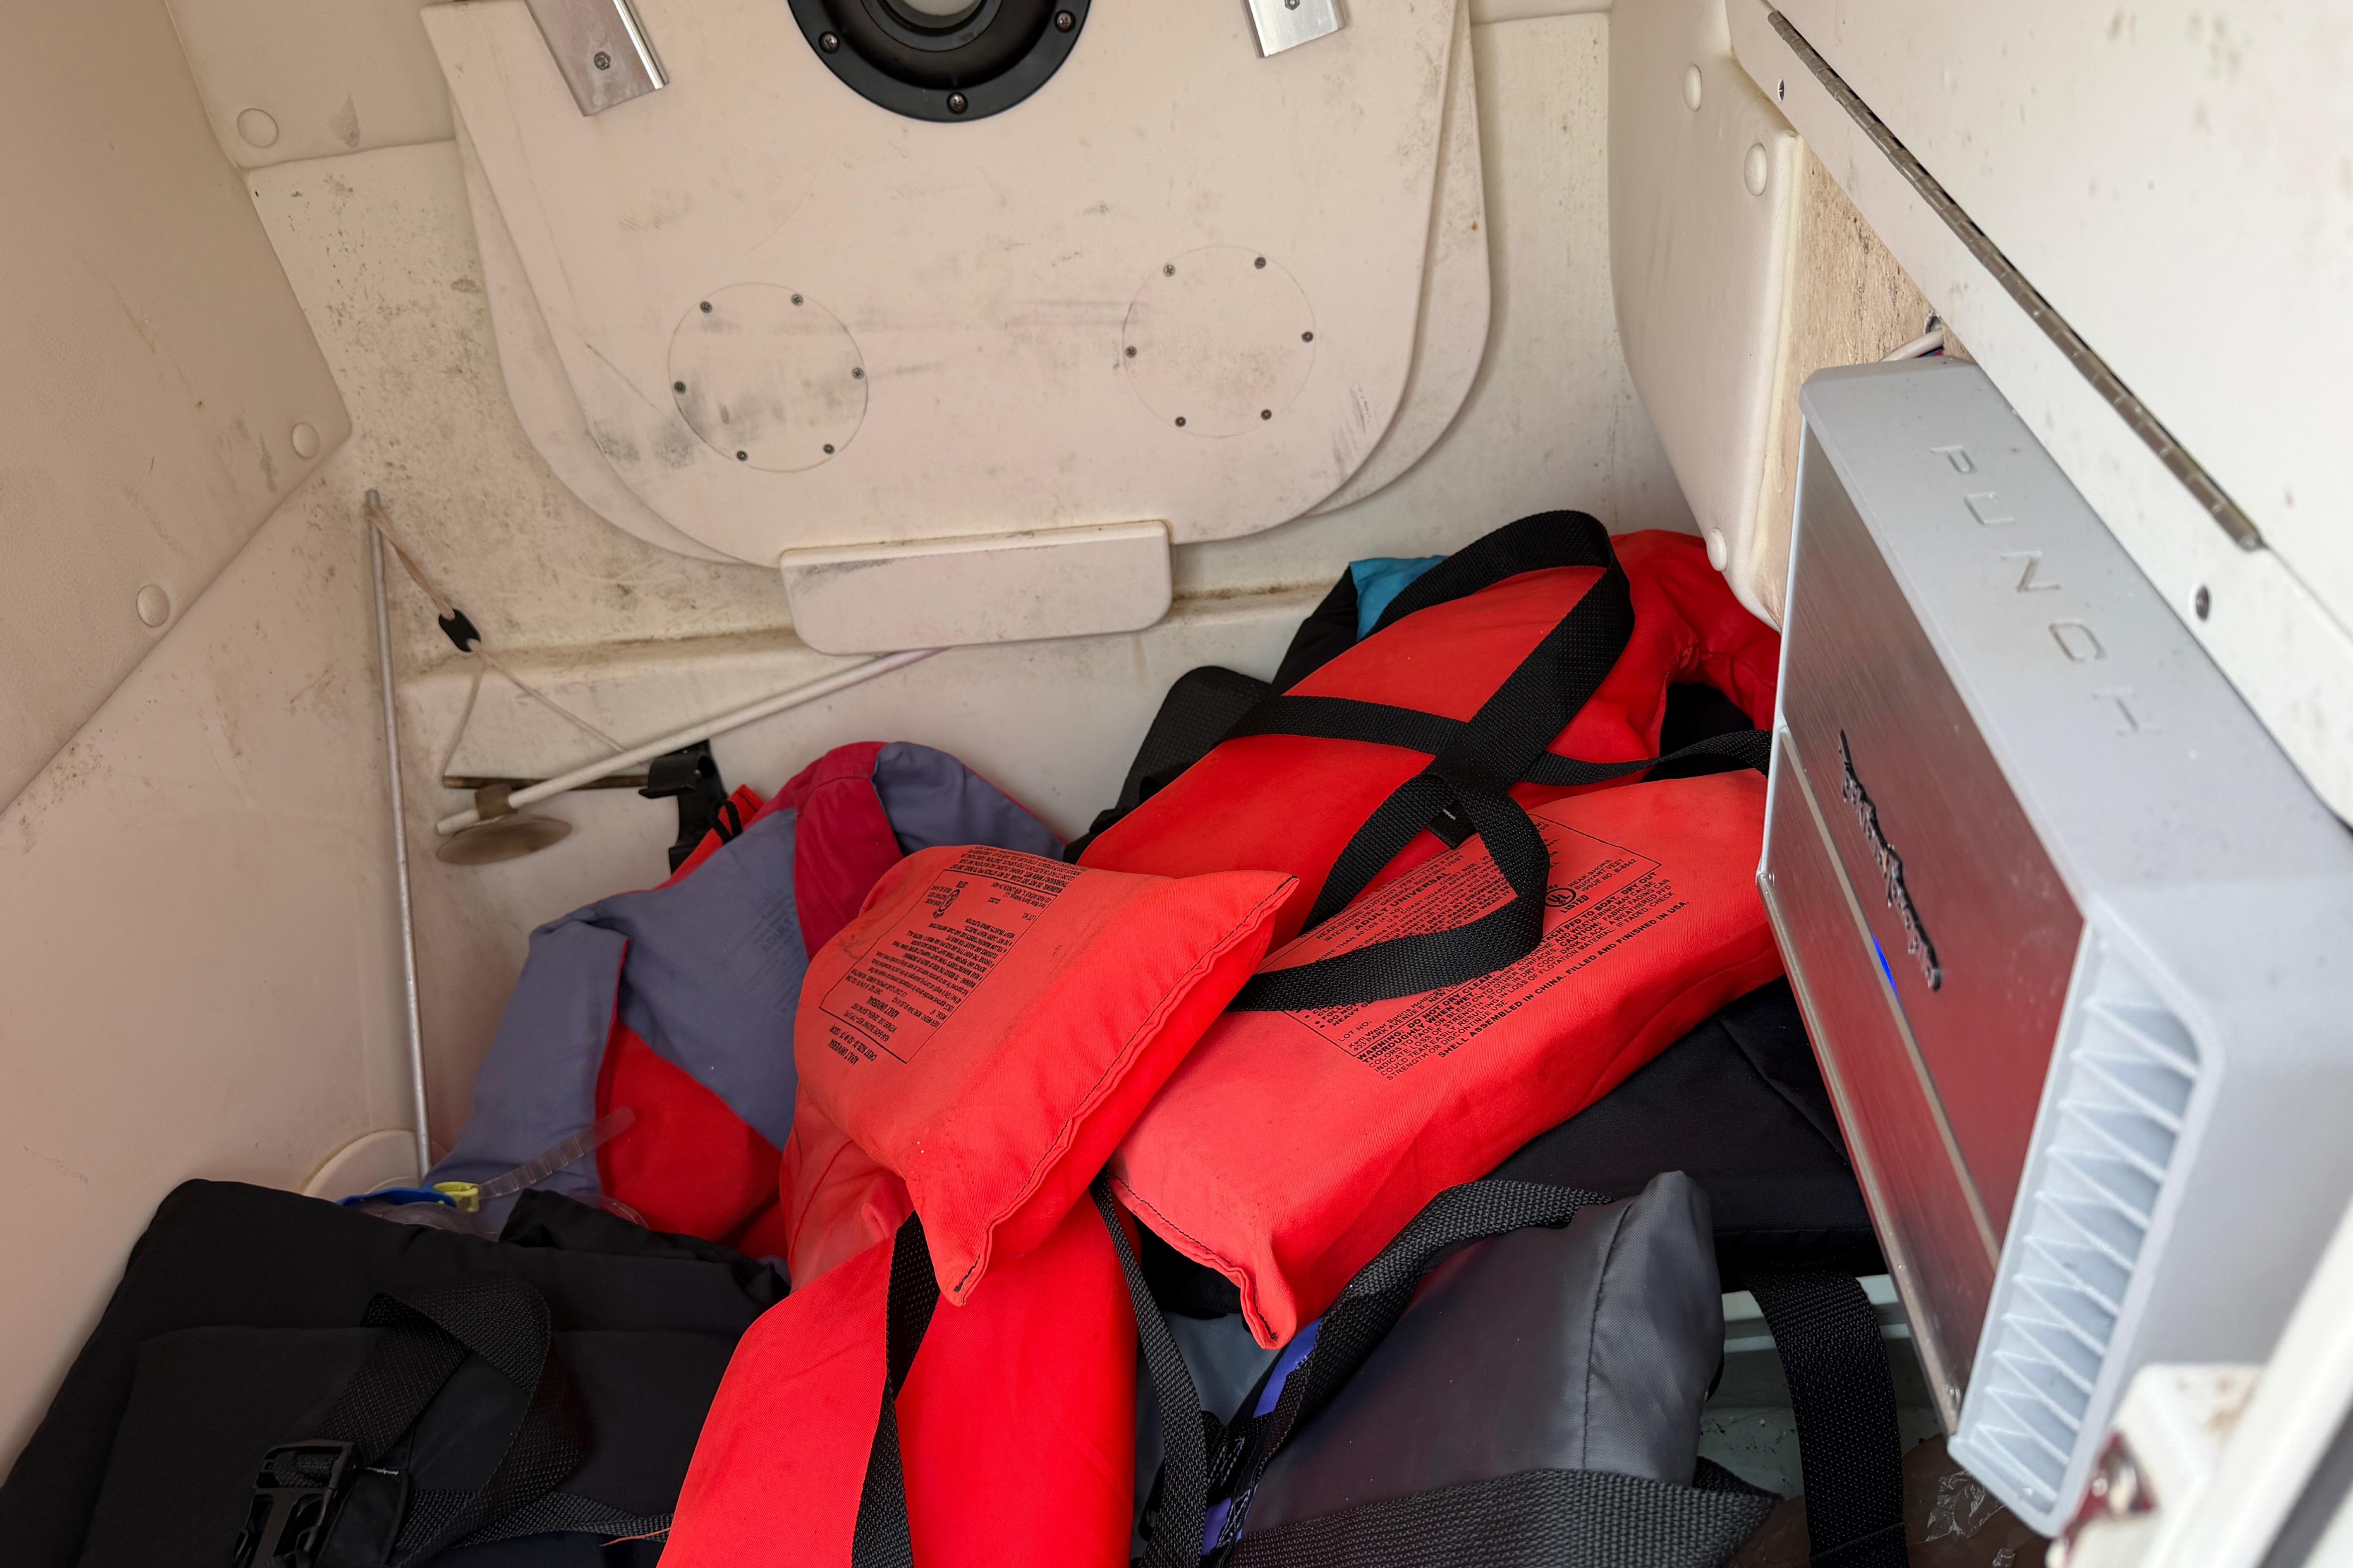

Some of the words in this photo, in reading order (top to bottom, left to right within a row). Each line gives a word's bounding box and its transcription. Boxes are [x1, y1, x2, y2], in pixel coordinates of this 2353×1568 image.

[1929, 445, 2165, 737] PUNCH
[1324, 918, 1360, 941] INTENDED
[1360, 907, 1378, 918] USE:
[1380, 886, 1414, 905] GENERAL
[1414, 867, 1445, 885] BOATING
[1445, 854, 1463, 866] VEST
[1354, 907, 1388, 930] ADULT
[1390, 873, 1450, 906] UNIVERSAL
[1401, 899, 1423, 914] COAST
[1424, 885, 1447, 899] GUARD
[1448, 866, 1482, 885] APPROVAL
[1439, 871, 1461, 885] CHEST
[1563, 918, 1582, 930] PFD
[1594, 895, 1619, 911] BOAT.
[1620, 882, 1638, 894] DRY
[1638, 872, 1657, 883] OUT
[1574, 868, 1606, 890] BUOYANT
[1605, 859, 1624, 869] VEST
[1427, 908, 1452, 924] DEATH
[1463, 909, 1479, 920] AND
[1560, 894, 1589, 913] LISTED
[1362, 1023, 1424, 1063] THOROUGHLY
[1425, 1005, 1454, 1023] WHEN
[1453, 992, 1477, 1005] WET.
[1554, 932, 1571, 943] AND
[1570, 904, 1616, 933] WEATHERING
[1614, 895, 1631, 905] MAY
[1630, 881, 1655, 896] CAUSE
[1369, 1046, 1402, 1068] COLORS
[1413, 1025, 1434, 1039] FADE
[1434, 1018, 1447, 1026] OR
[1446, 1001, 1471, 1018] BLEED
[1471, 987, 1493, 1002] ONTO
[1493, 971, 1519, 988] OTHER
[1518, 948, 1558, 971] SURFACES.
[1559, 922, 1601, 946] CAUTION:
[1602, 904, 1629, 921] FABRIC
[1628, 888, 1654, 905] FADING
[1653, 879, 1670, 888] CAN
[1374, 1048, 1410, 1072] INDICATE
[1410, 1035, 1432, 1049] LOSS
[1431, 1027, 1441, 1035] OF
[1443, 1001, 1483, 1028] STRENGTH.
[1487, 982, 1512, 999] STORE
[1559, 940, 1582, 954] DARK
[1614, 894, 1657, 921] WEATHERED
[1655, 884, 1671, 895] PFD
[1380, 1058, 1408, 1076] COULD
[1407, 1044, 1430, 1057] TEAR
[1457, 998, 1499, 1026] RESULTING
[1507, 980, 1528, 993] LOSS
[1538, 949, 1578, 974] FLOTATION
[1577, 929, 1615, 950] MATERIAL.
[1649, 891, 1675, 907] CHECK
[1438, 1038, 1469, 1057] SHELL
[1470, 1001, 1522, 1037] ASSEMBLED
[1535, 976, 1566, 994] CHINA.
[1565, 955, 1597, 974] FILLED
[1597, 943, 1616, 956] AND
[1616, 919, 1656, 944] FINISHED
[1666, 901, 1689, 913] USA.
[1327, 1014, 1339, 1023] DO
[1340, 1001, 1357, 1015] NOT
[1332, 1007, 1359, 1026] HEAVY
[1338, 1030, 1354, 1042] LOT
[1355, 1021, 1372, 1031] NO.
[1348, 1036, 1366, 1048] Kent
[1365, 1023, 1386, 1036] Water
[1387, 1008, 1413, 1023] Sports
[1353, 1041, 1366, 1051] 433
[1366, 1028, 1388, 1042] PARK
[1389, 1009, 1418, 1029] AVENUE
[1428, 990, 1446, 1003] NEW
[1357, 1030, 1404, 1060] WARNING:
[1406, 1018, 1421, 1028] DO
[1421, 1005, 1440, 1019] NOT
[1441, 993, 1460, 1006] DRY
[1462, 971, 1495, 993] CLEAN.
[1386, 1053, 1428, 1080] STRENGTH
[1429, 1044, 1441, 1053] OR
[1440, 1011, 1491, 1045] DISCONTINUE
[1491, 999, 1508, 1011] USE.
